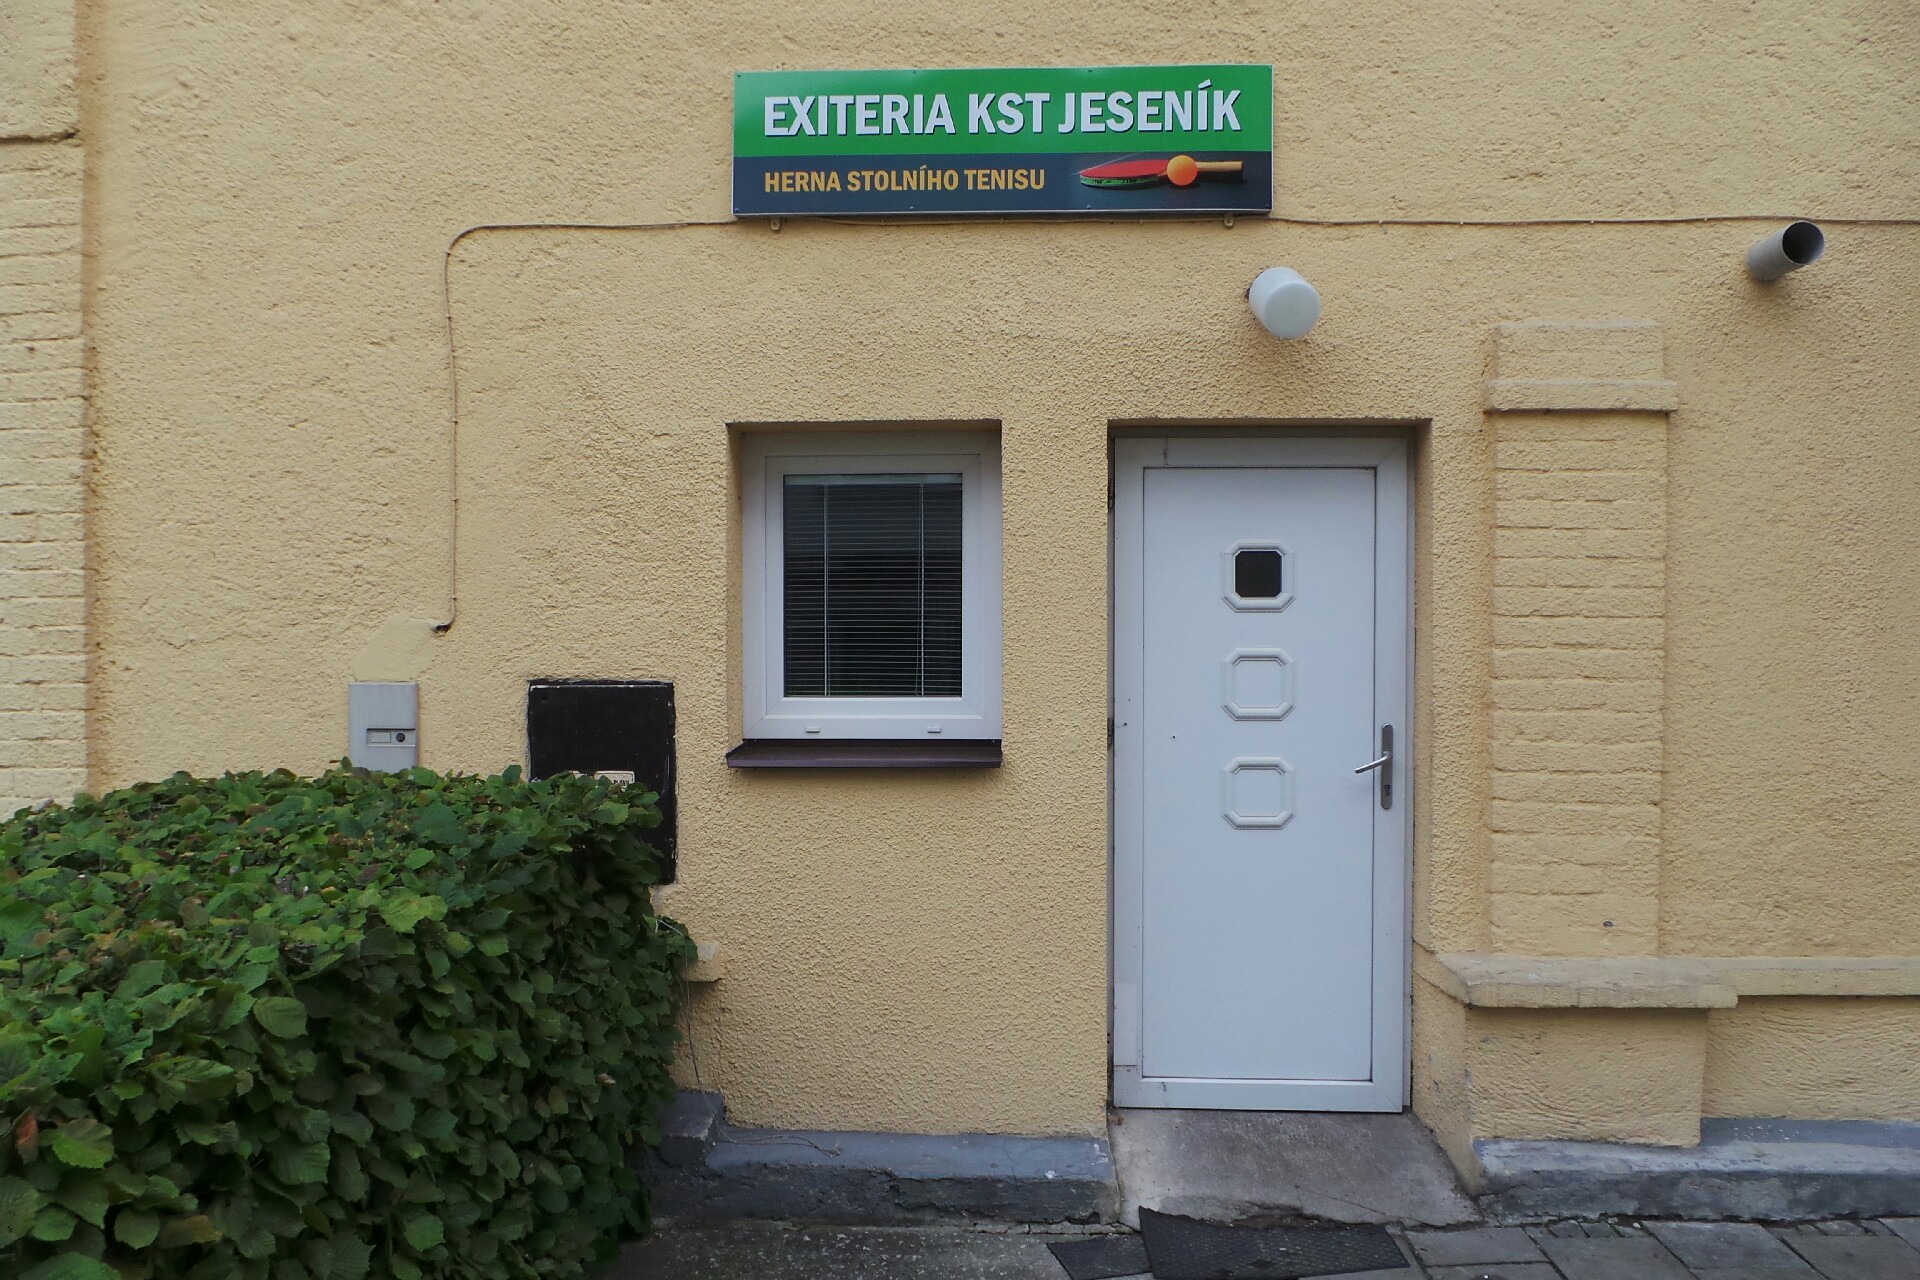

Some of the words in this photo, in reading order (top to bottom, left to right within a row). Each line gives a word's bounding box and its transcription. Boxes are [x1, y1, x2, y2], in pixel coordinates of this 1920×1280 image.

[764, 93, 956, 136] EXITERIA
[968, 92, 1050, 134] KST
[1058, 78, 1242, 133] JESENÍK
[764, 170, 842, 193] HERNA
[846, 164, 960, 192] STOLNÍHO
[963, 168, 1046, 191] TENISU
